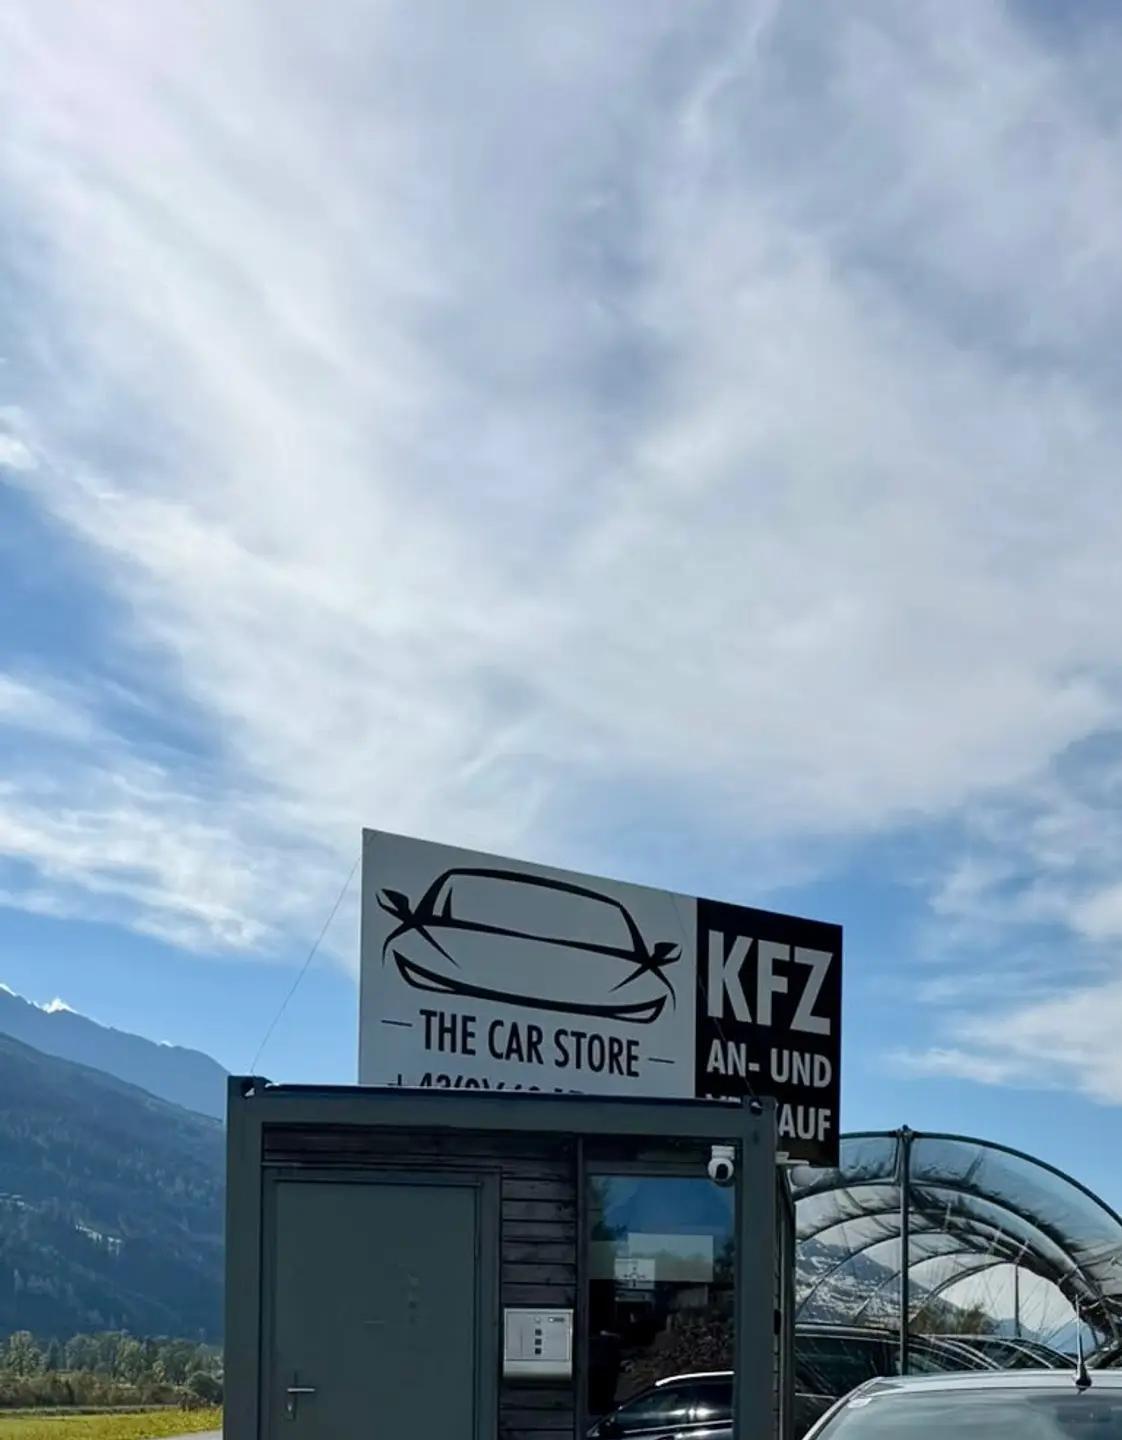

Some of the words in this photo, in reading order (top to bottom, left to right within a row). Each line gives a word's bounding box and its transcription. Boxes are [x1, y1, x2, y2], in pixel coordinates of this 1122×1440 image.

[708, 929, 834, 1036] KFZ
[420, 1008, 476, 1056] THE
[488, 1019, 544, 1065] CAR
[554, 1028, 640, 1078] STORE
[706, 1039, 760, 1077] AN-
[770, 1048, 832, 1088] UND
